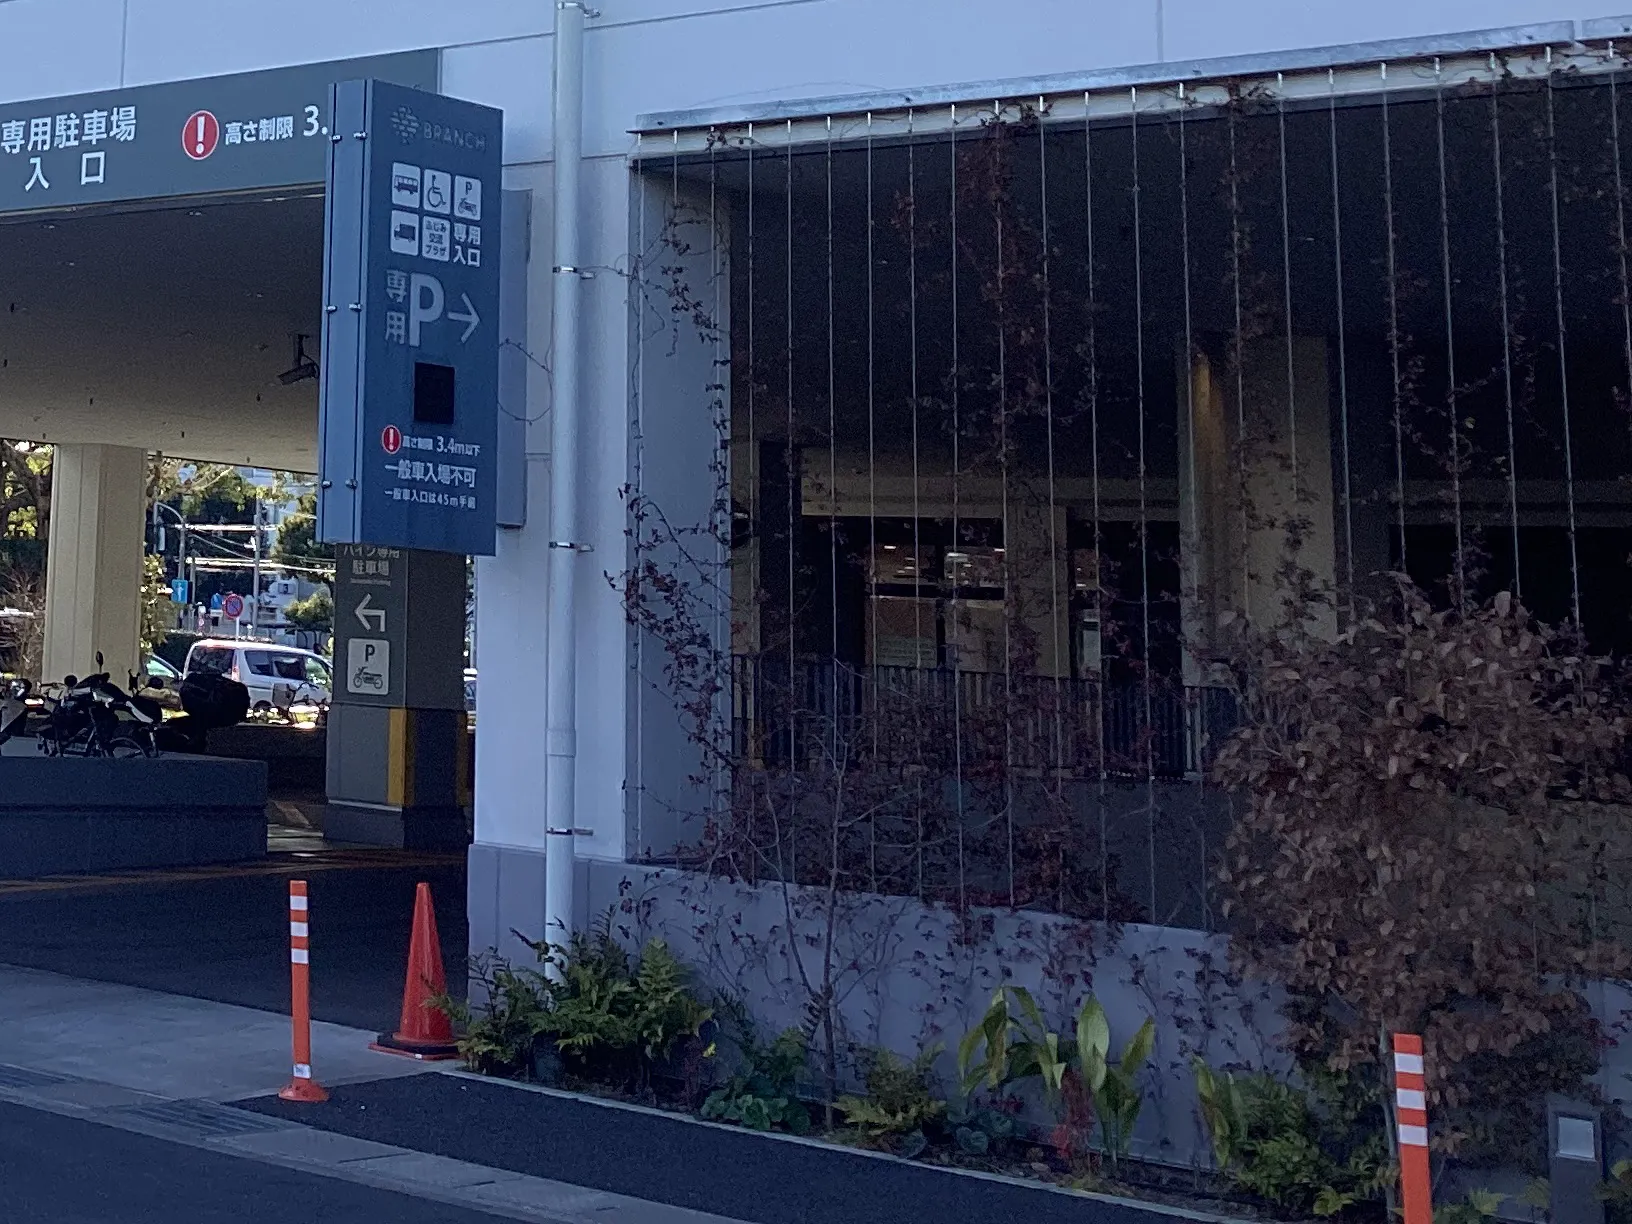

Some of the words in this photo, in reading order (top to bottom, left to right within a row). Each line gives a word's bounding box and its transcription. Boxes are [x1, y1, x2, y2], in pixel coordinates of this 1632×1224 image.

[0, 105, 137, 154] 専用駐車場
[225, 115, 295, 146] 高さ制限
[423, 122, 487, 152] BRANCH
[453, 245, 481, 267] 入口
[409, 272, 445, 347] P
[384, 458, 477, 488] 一般車入場不可
